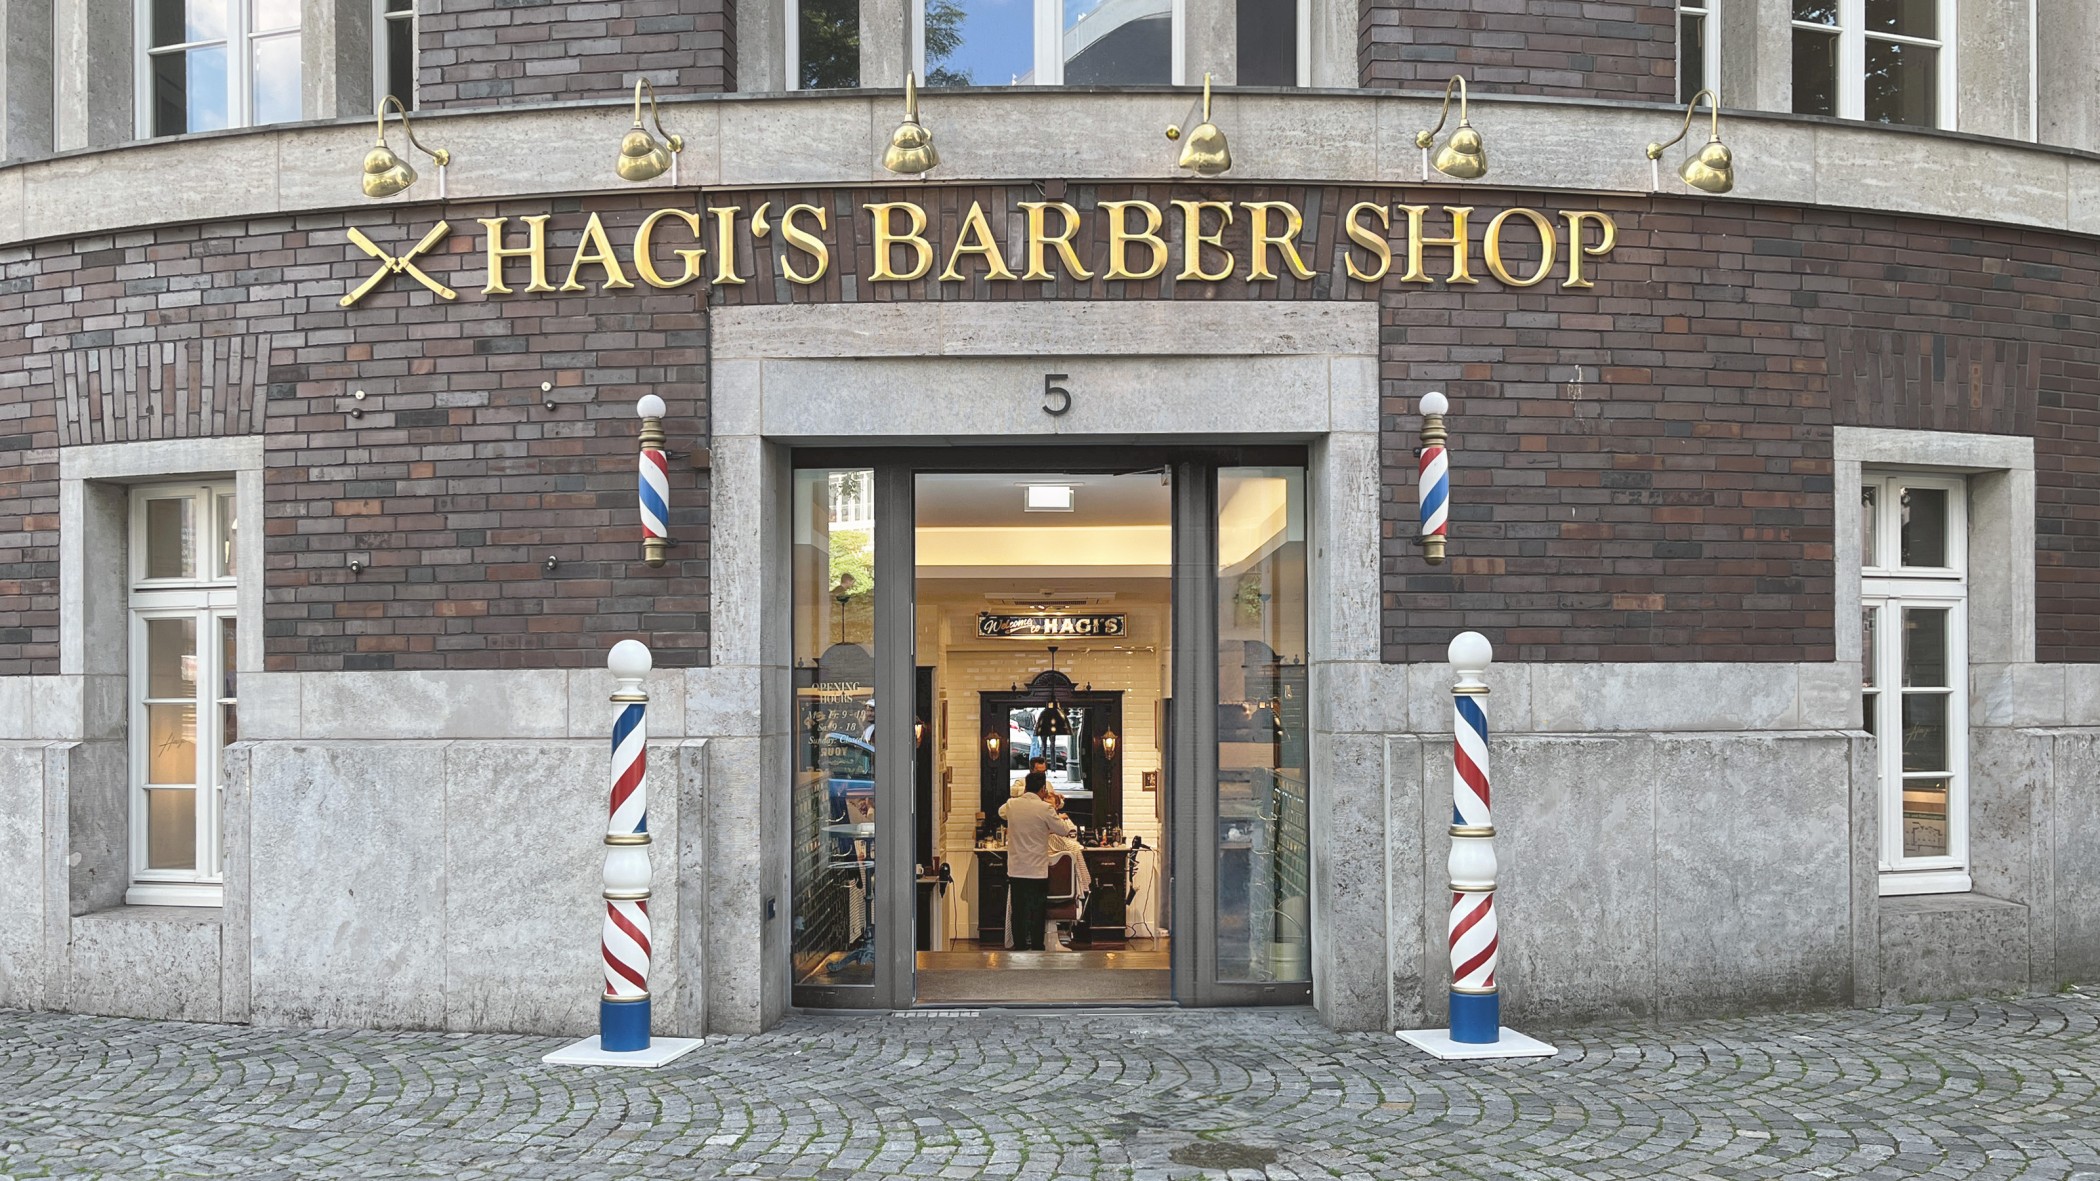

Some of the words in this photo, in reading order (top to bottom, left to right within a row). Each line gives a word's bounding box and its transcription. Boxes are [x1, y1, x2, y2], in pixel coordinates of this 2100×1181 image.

[863, 200, 1316, 283] BARBER
[1344, 201, 1618, 288] SHOP
[1041, 373, 1071, 416] 5
[983, 618, 1033, 634] Welcome
[1043, 618, 1118, 634] HAGI'S
[812, 681, 859, 691] OPENING
[820, 695, 852, 703] HOURS
[841, 710, 848, 719] 9
[846, 722, 857, 731] 18
